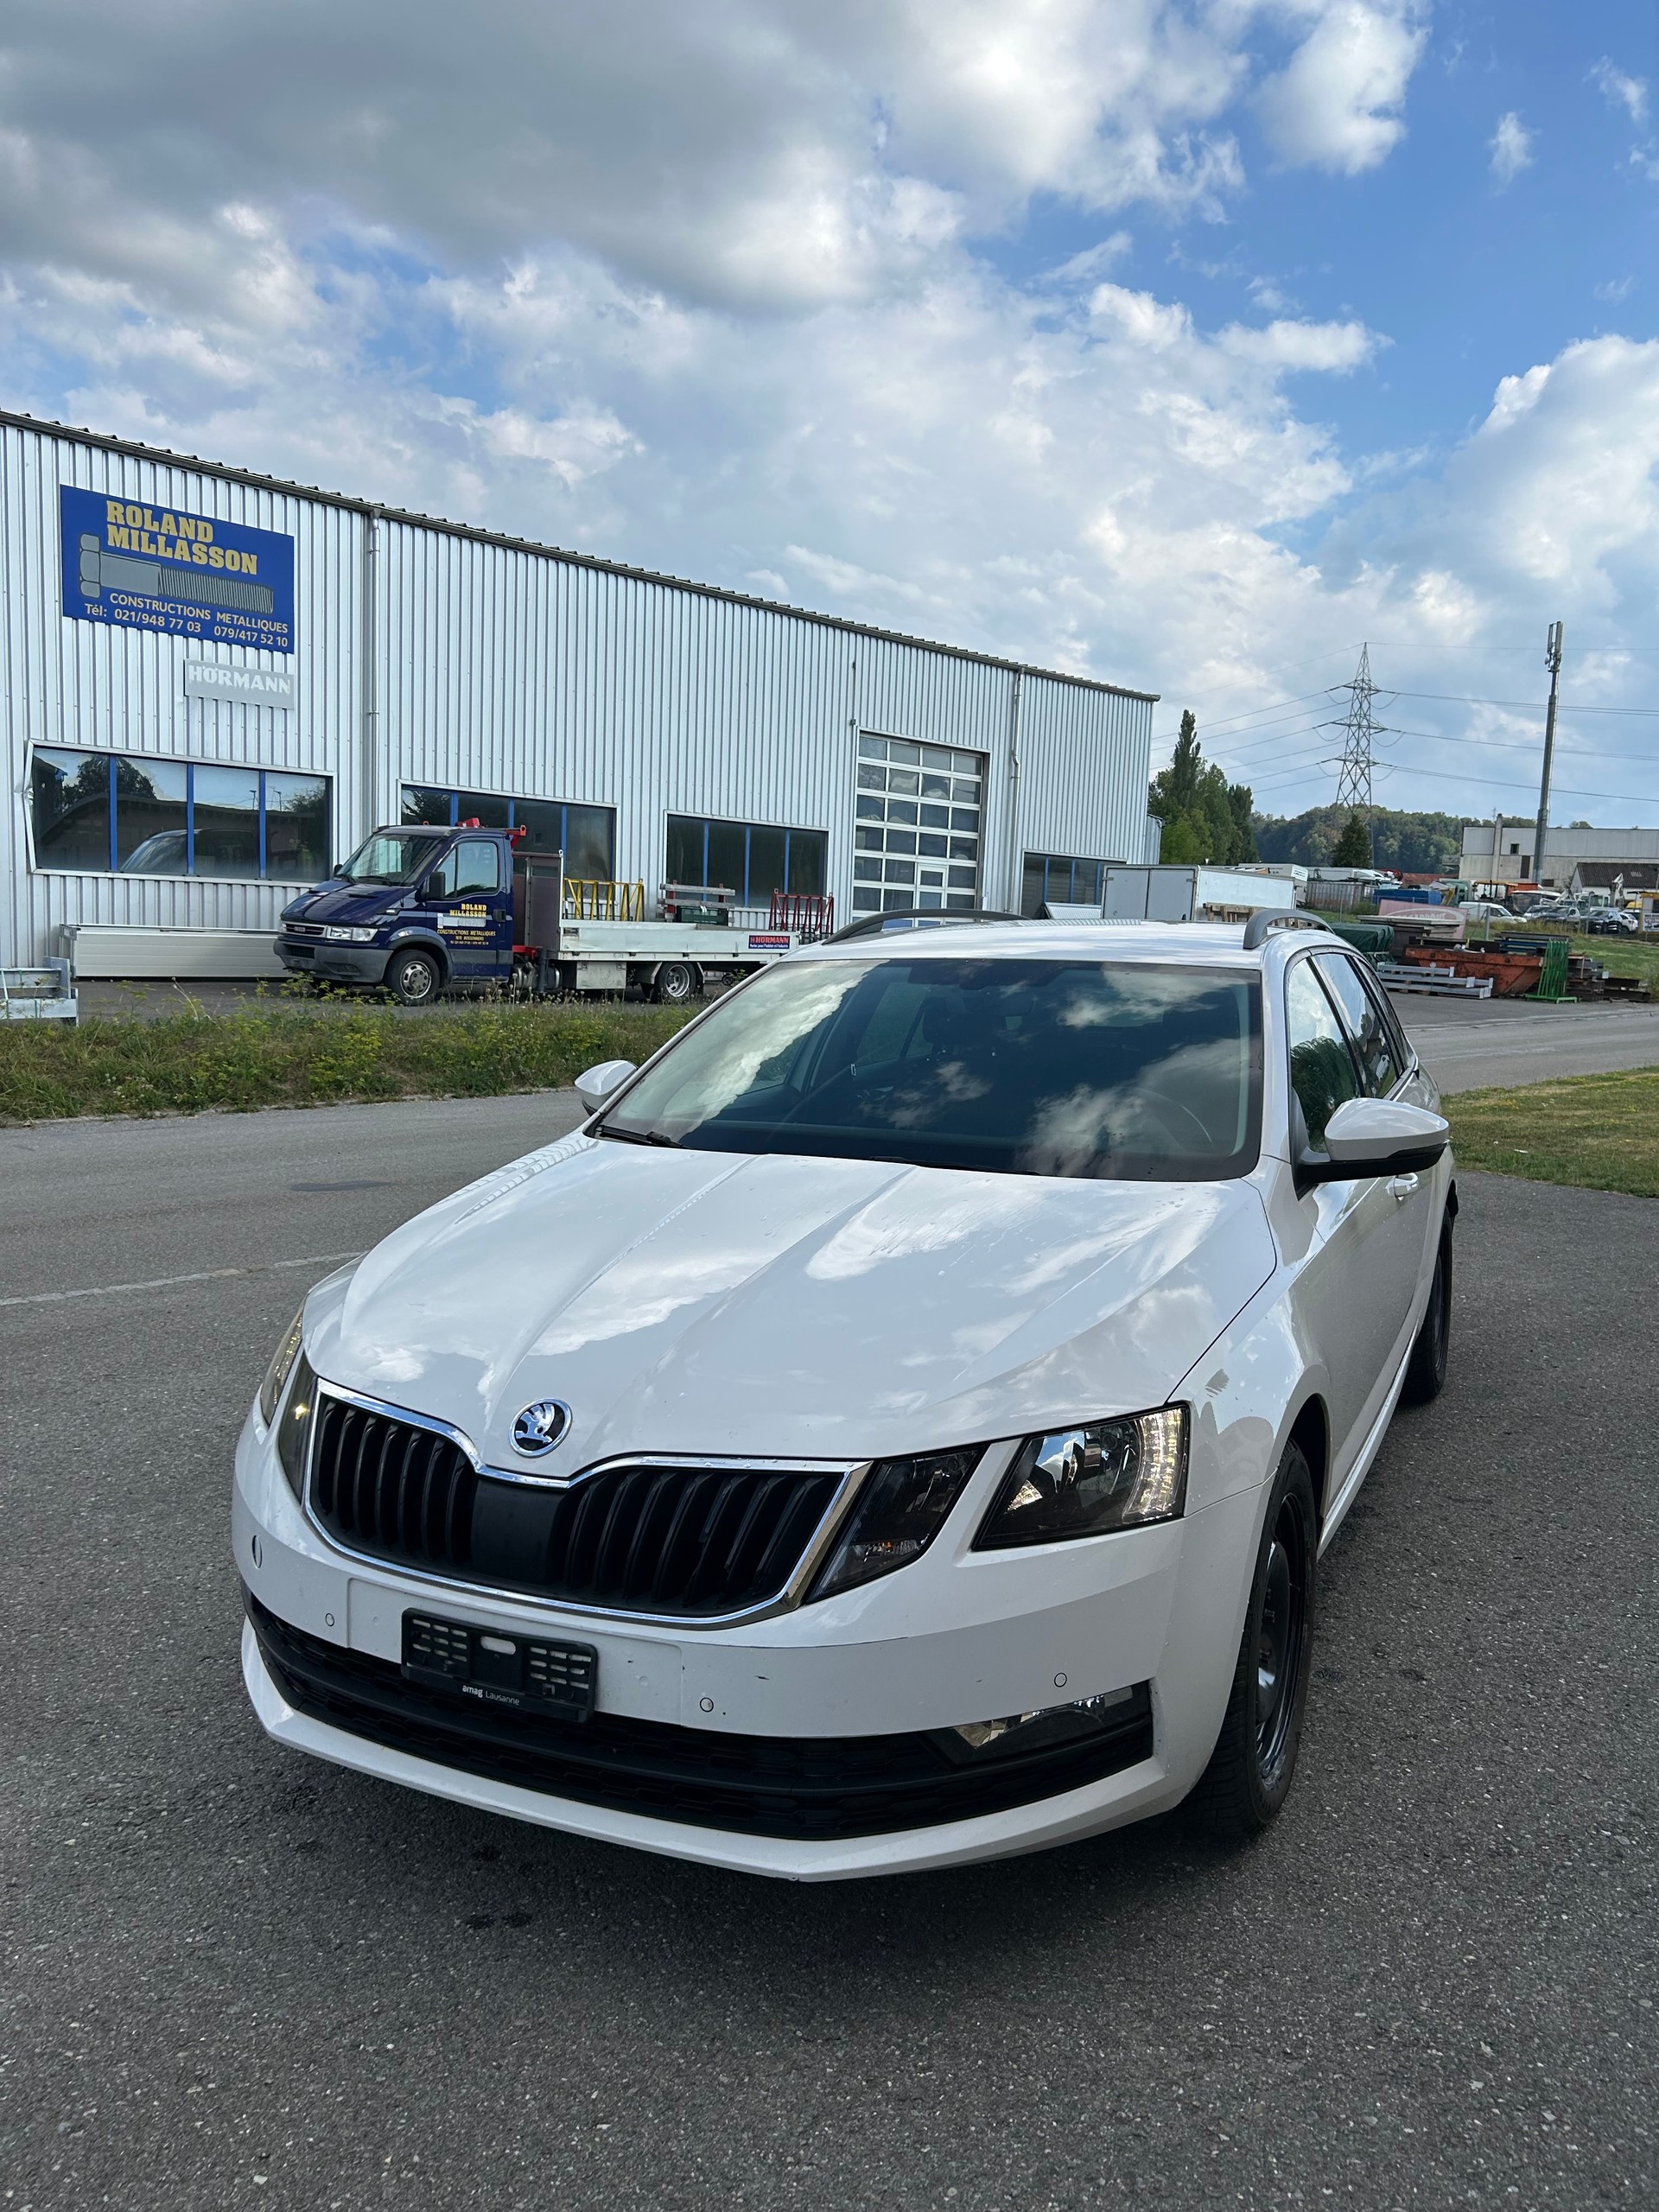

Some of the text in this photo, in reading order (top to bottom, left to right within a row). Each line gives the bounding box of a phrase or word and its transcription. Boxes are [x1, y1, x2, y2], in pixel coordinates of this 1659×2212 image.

[106, 500, 214, 543] ROLAND
[107, 524, 257, 575] MILLASSON
[85, 603, 289, 647] Tél: 021/948 77 03 079/417 52 10
[110, 593, 289, 633] CONSTRUCTIONS METALLIQUES
[449, 909, 486, 918] MILLASSON
[462, 1685, 520, 1706] amag Lausanne
